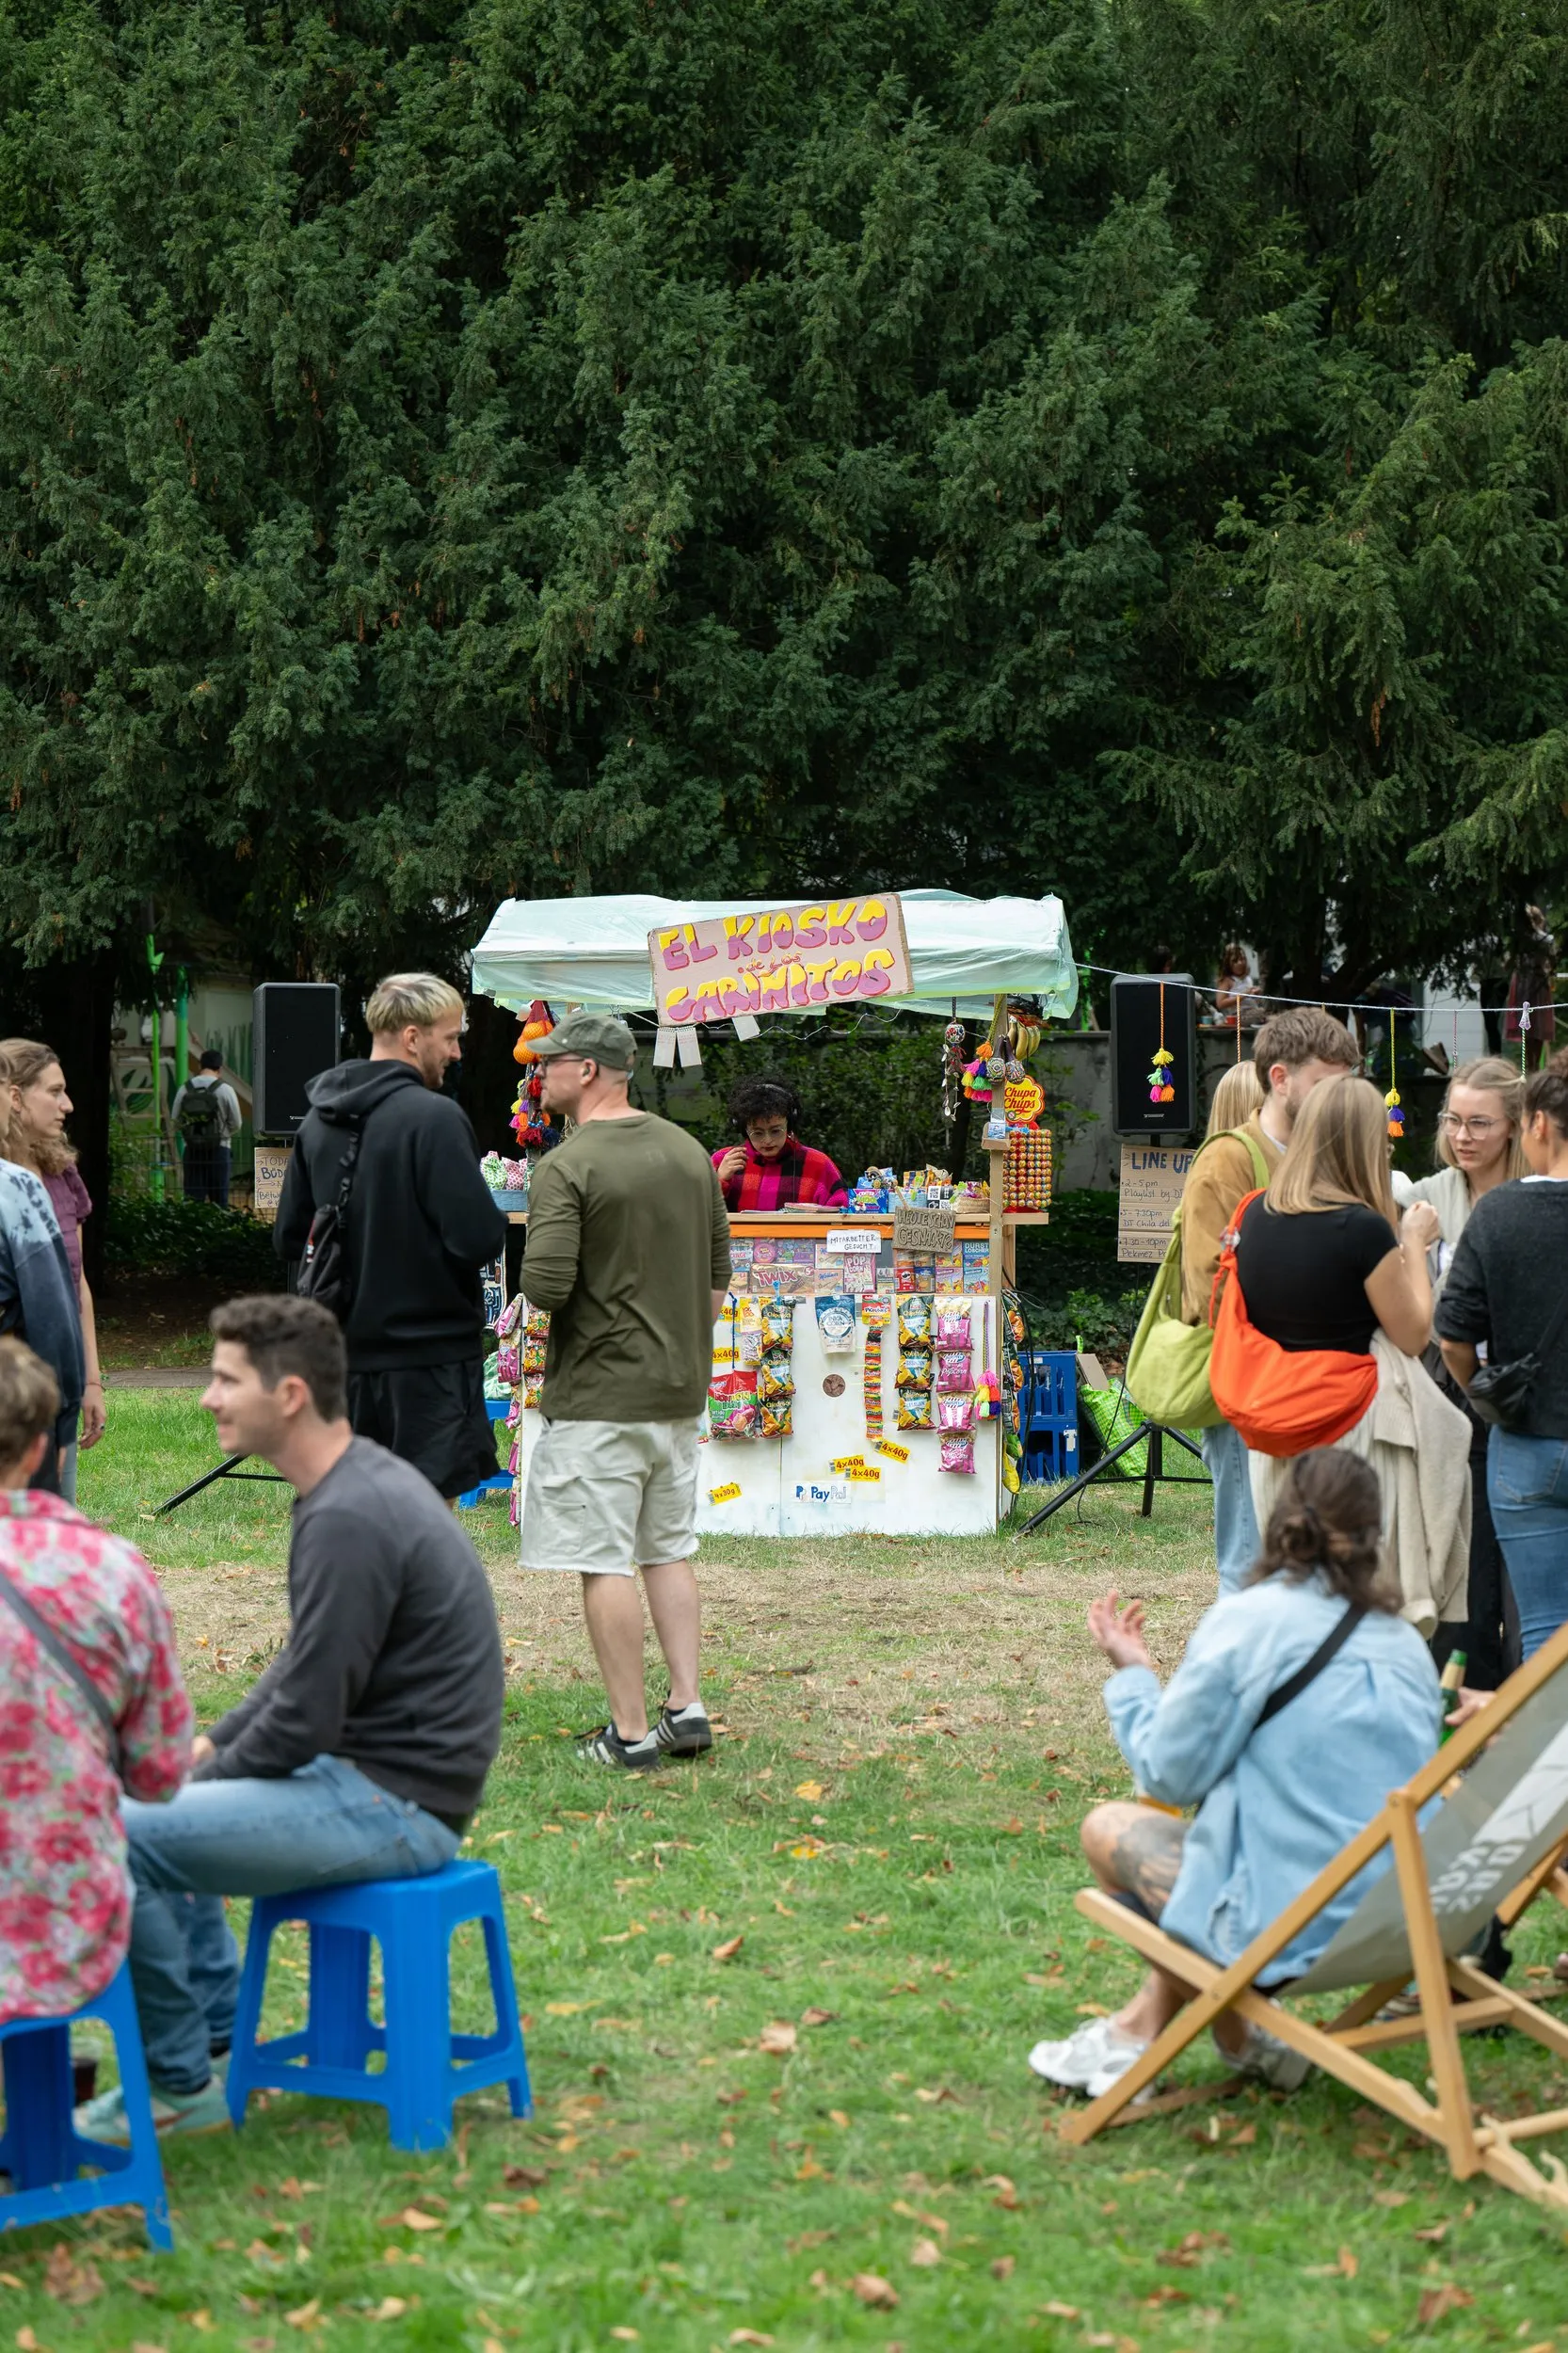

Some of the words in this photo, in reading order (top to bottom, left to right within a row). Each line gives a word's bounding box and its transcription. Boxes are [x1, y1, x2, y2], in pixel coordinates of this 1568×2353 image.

[658, 923, 718, 971] EL
[723, 899, 888, 960] KIOSKO
[1004, 1086, 1037, 1102] Chupa
[1003, 1098, 1036, 1112] Chups
[1131, 1152, 1168, 1170] LINE
[1173, 1152, 1193, 1174] UP
[1124, 1189, 1155, 1201] Playlist
[1160, 1189, 1171, 1202] by
[897, 1209, 928, 1226] HEUTE
[928, 1211, 955, 1228] SCHON
[829, 1234, 876, 1244] MITARBEITER
[1122, 1249, 1153, 1258] Pekmez
[846, 1256, 866, 1267] POP
[810, 1485, 847, 1502] PayPal
